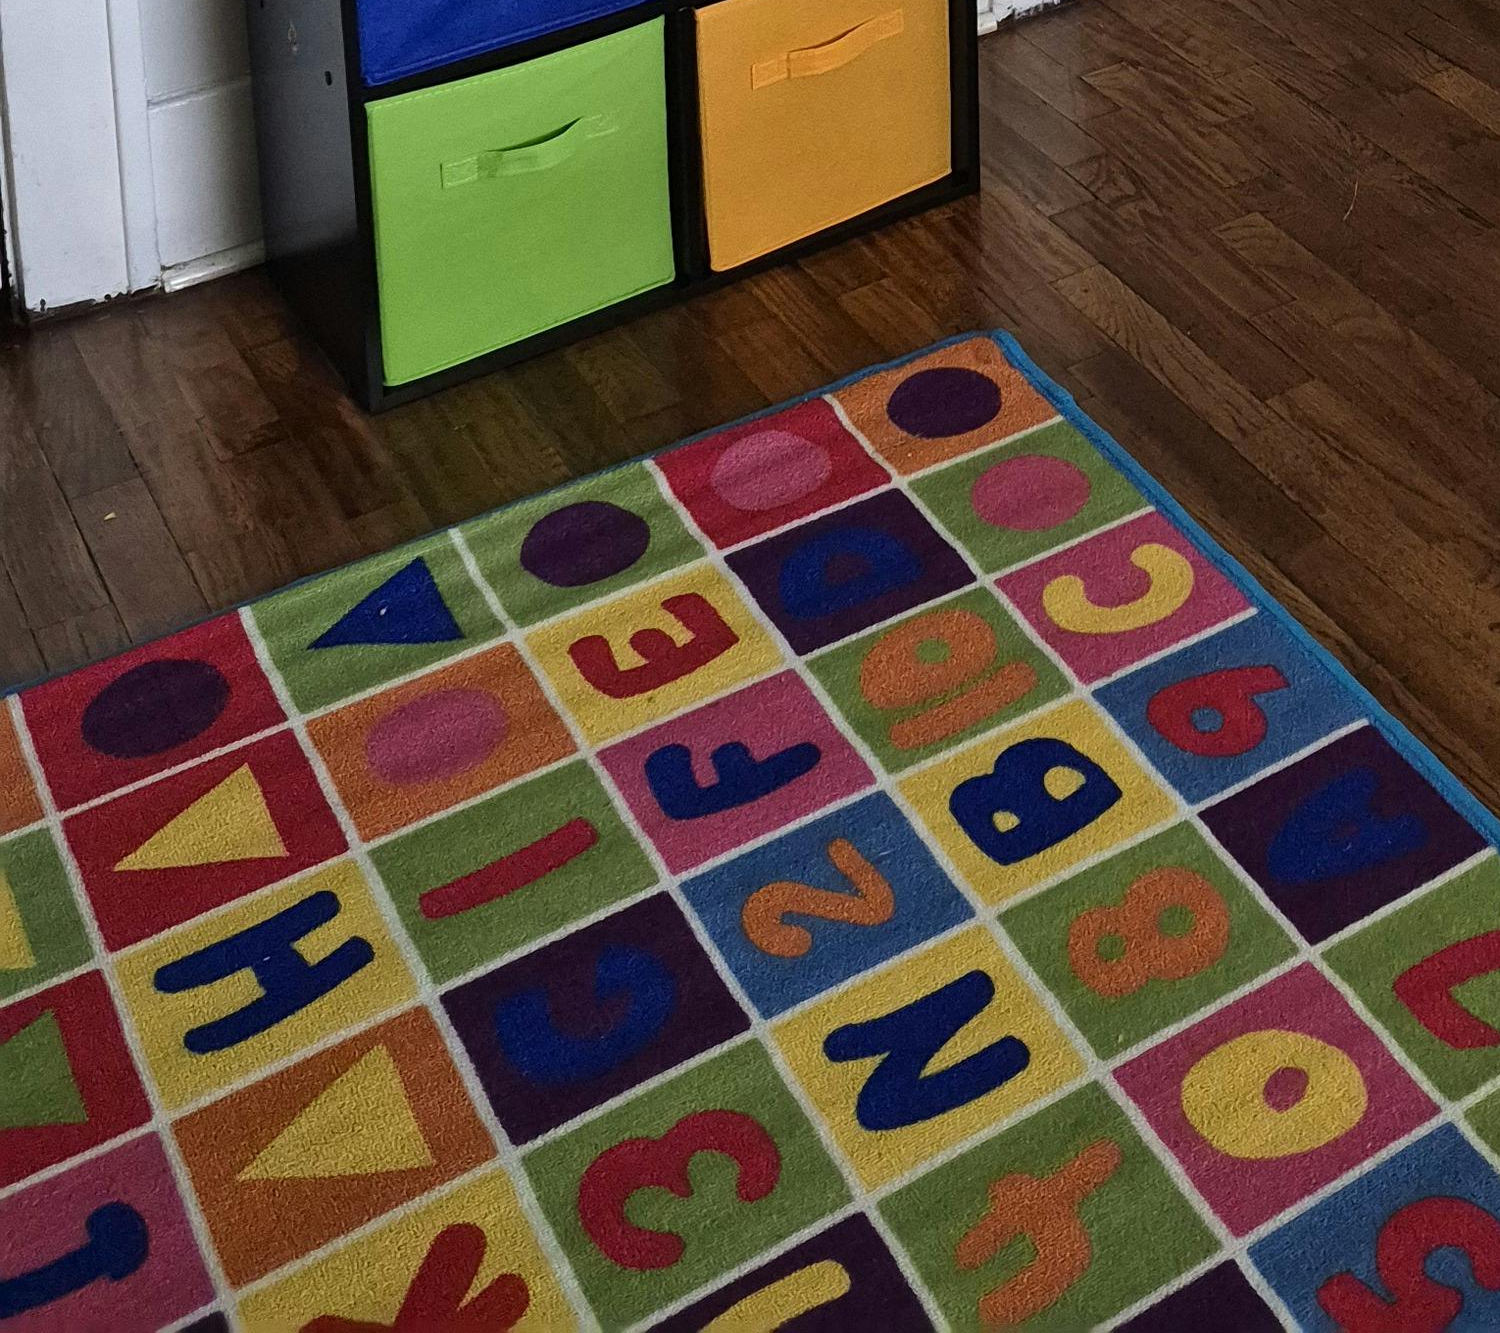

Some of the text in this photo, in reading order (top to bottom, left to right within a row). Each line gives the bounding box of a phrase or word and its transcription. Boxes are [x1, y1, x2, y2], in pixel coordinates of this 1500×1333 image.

[568, 591, 740, 699] E
[1043, 542, 1195, 635] C
[859, 609, 1039, 752] 10
[643, 738, 822, 820] F
[948, 737, 1123, 866] B
[740, 837, 895, 959] 2
[1068, 867, 1231, 999] 8
[153, 889, 375, 1054] H
[822, 968, 1031, 1132] N
[578, 1108, 781, 1271] 3
[953, 1139, 1122, 1329] 4
